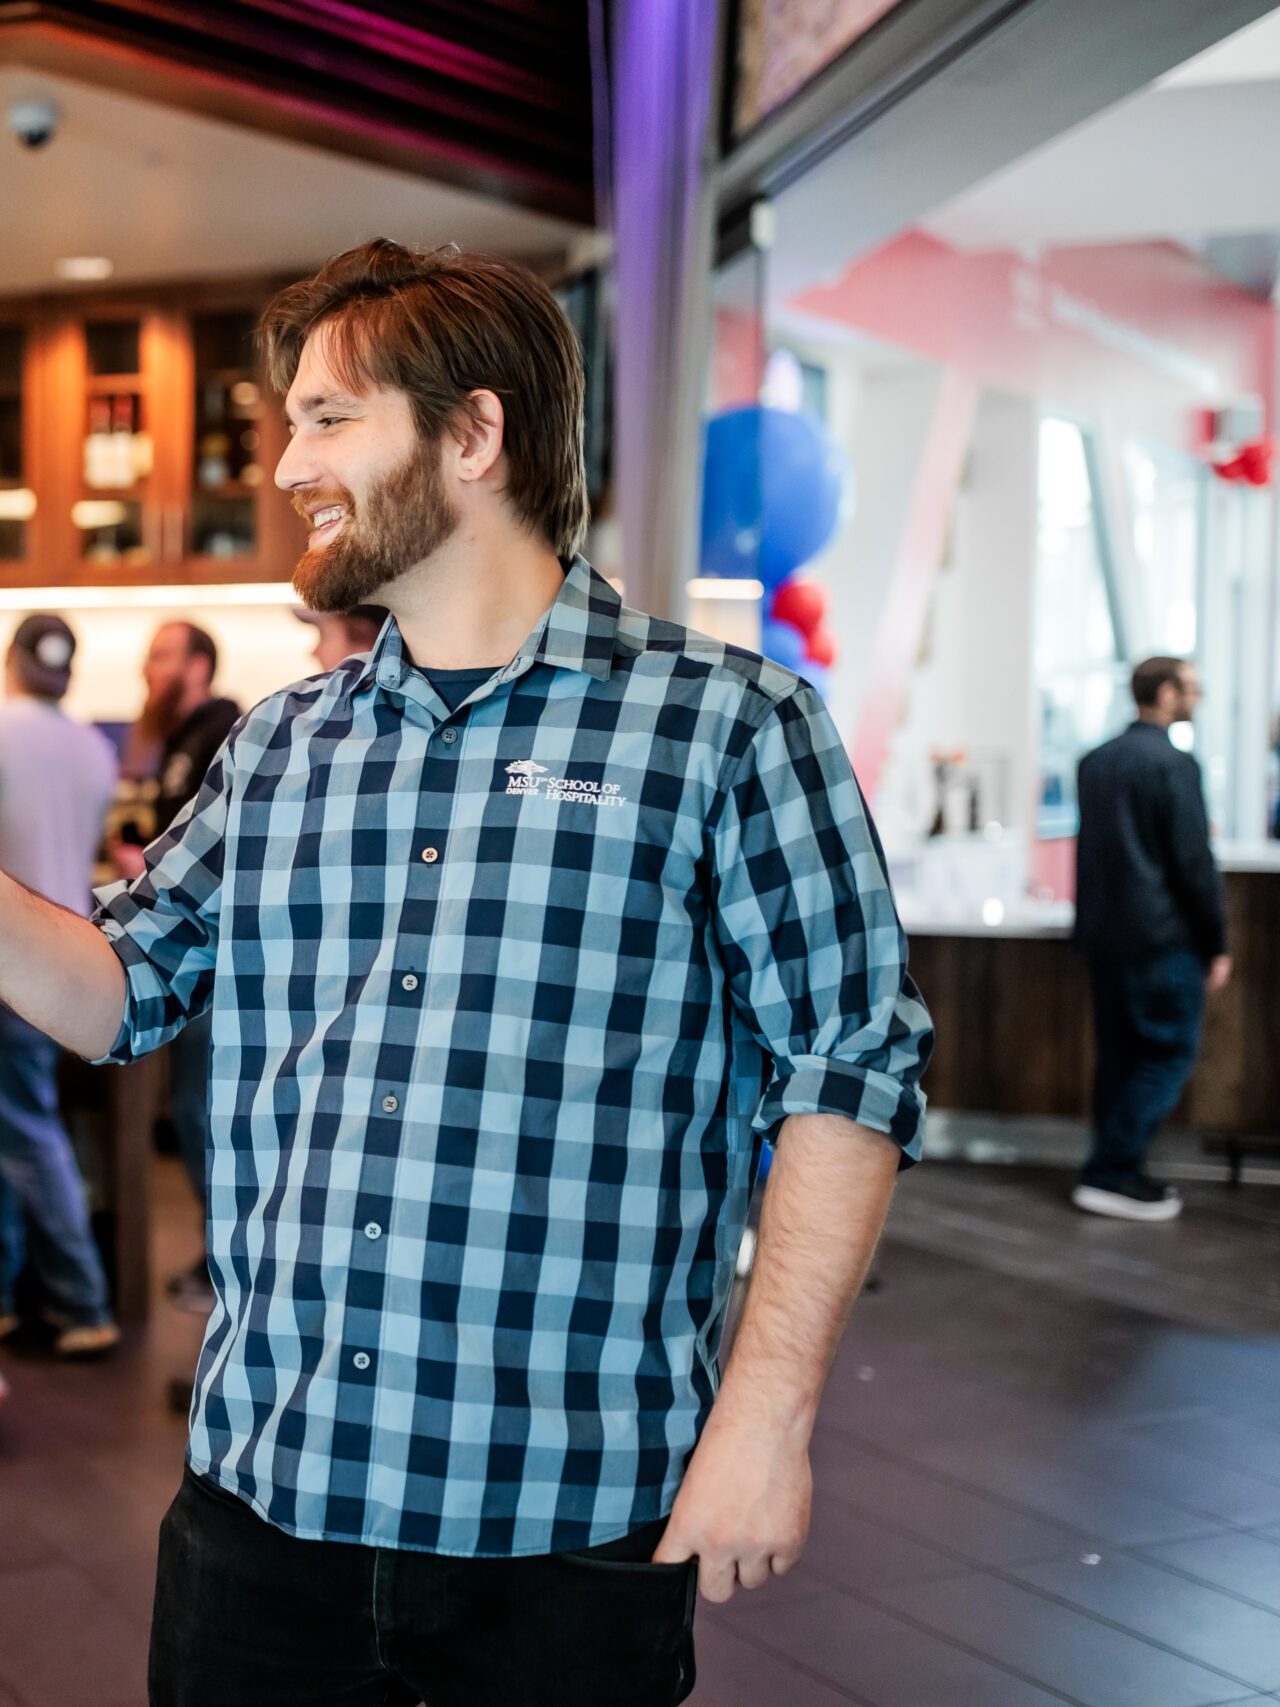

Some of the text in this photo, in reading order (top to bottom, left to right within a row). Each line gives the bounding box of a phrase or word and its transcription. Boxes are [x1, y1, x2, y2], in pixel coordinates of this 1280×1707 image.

[547, 777, 621, 795] SCHOOL OF
[546, 788, 626, 807] HOSPITALITY
